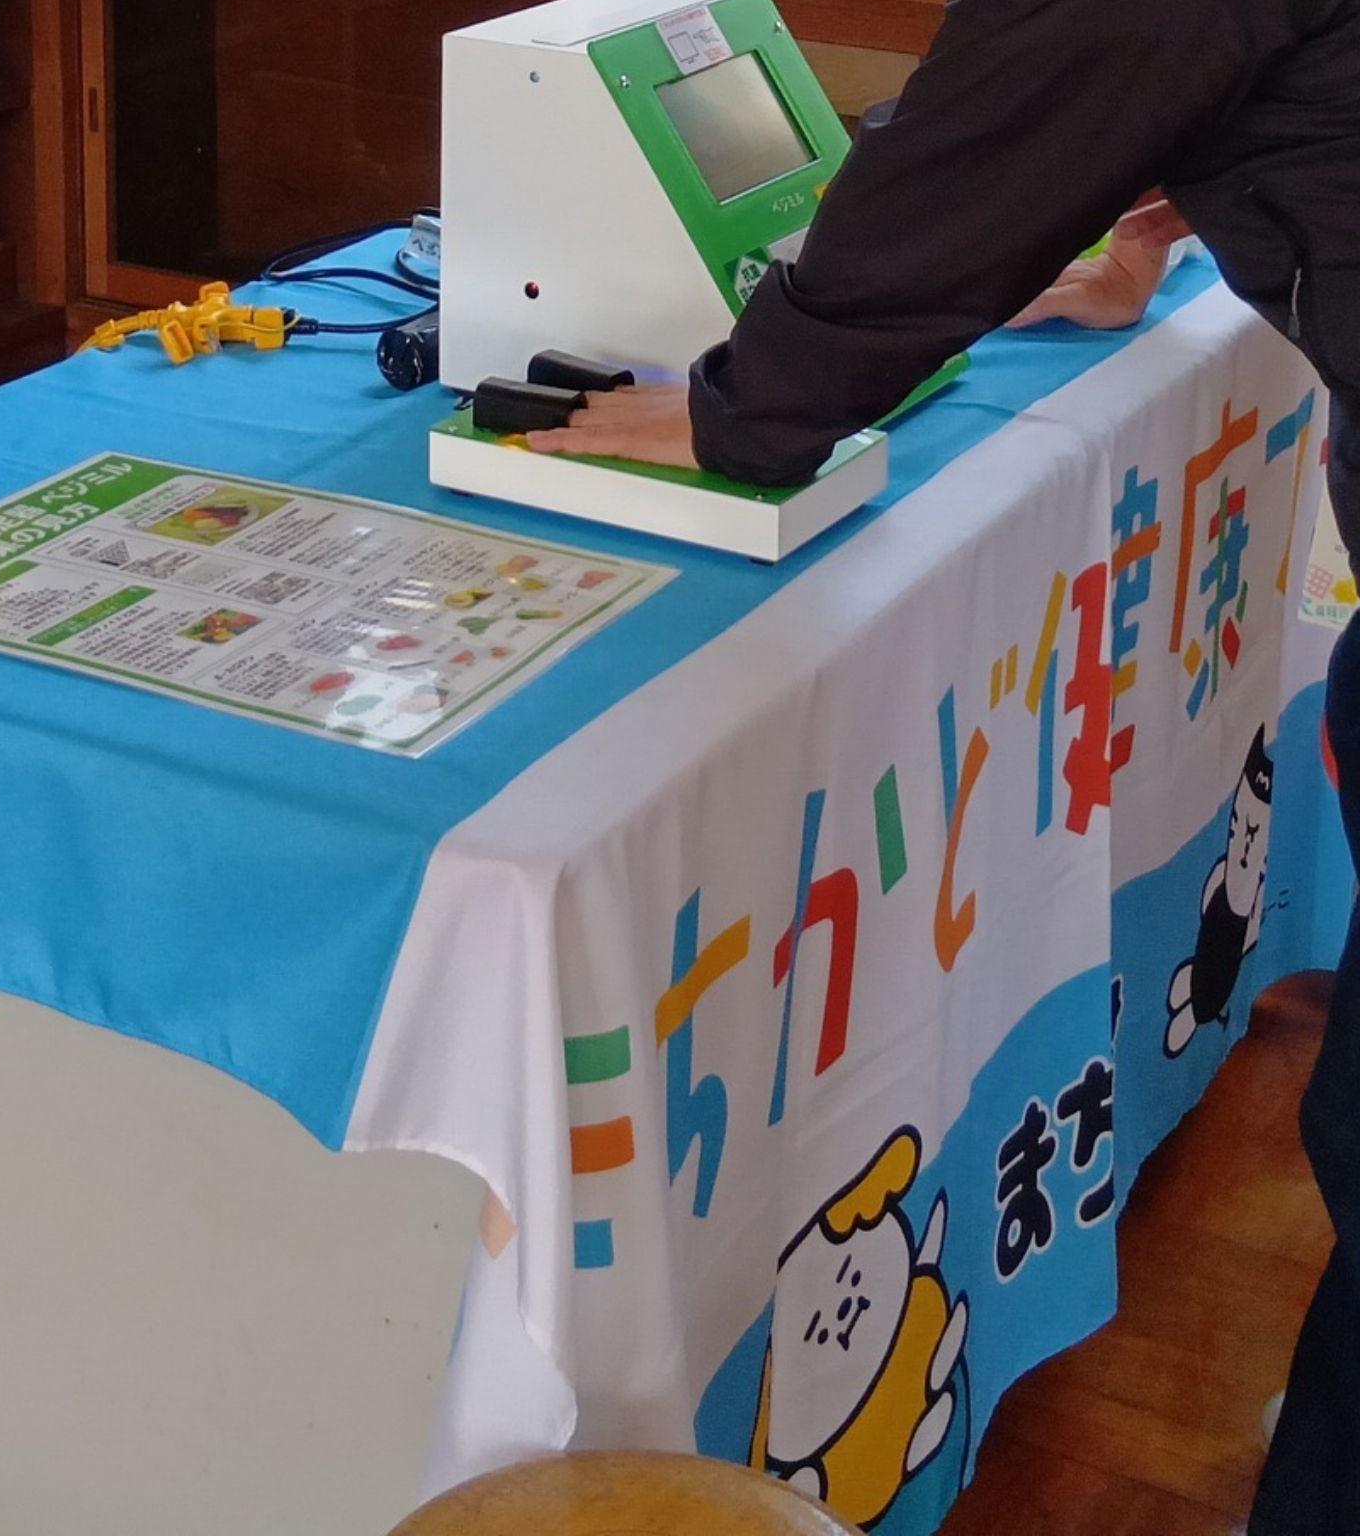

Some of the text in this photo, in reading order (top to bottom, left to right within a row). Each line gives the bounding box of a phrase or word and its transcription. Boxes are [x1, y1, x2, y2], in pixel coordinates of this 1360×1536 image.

[40, 462, 133, 505] ベジミル
[996, 974, 1123, 1279] まち
